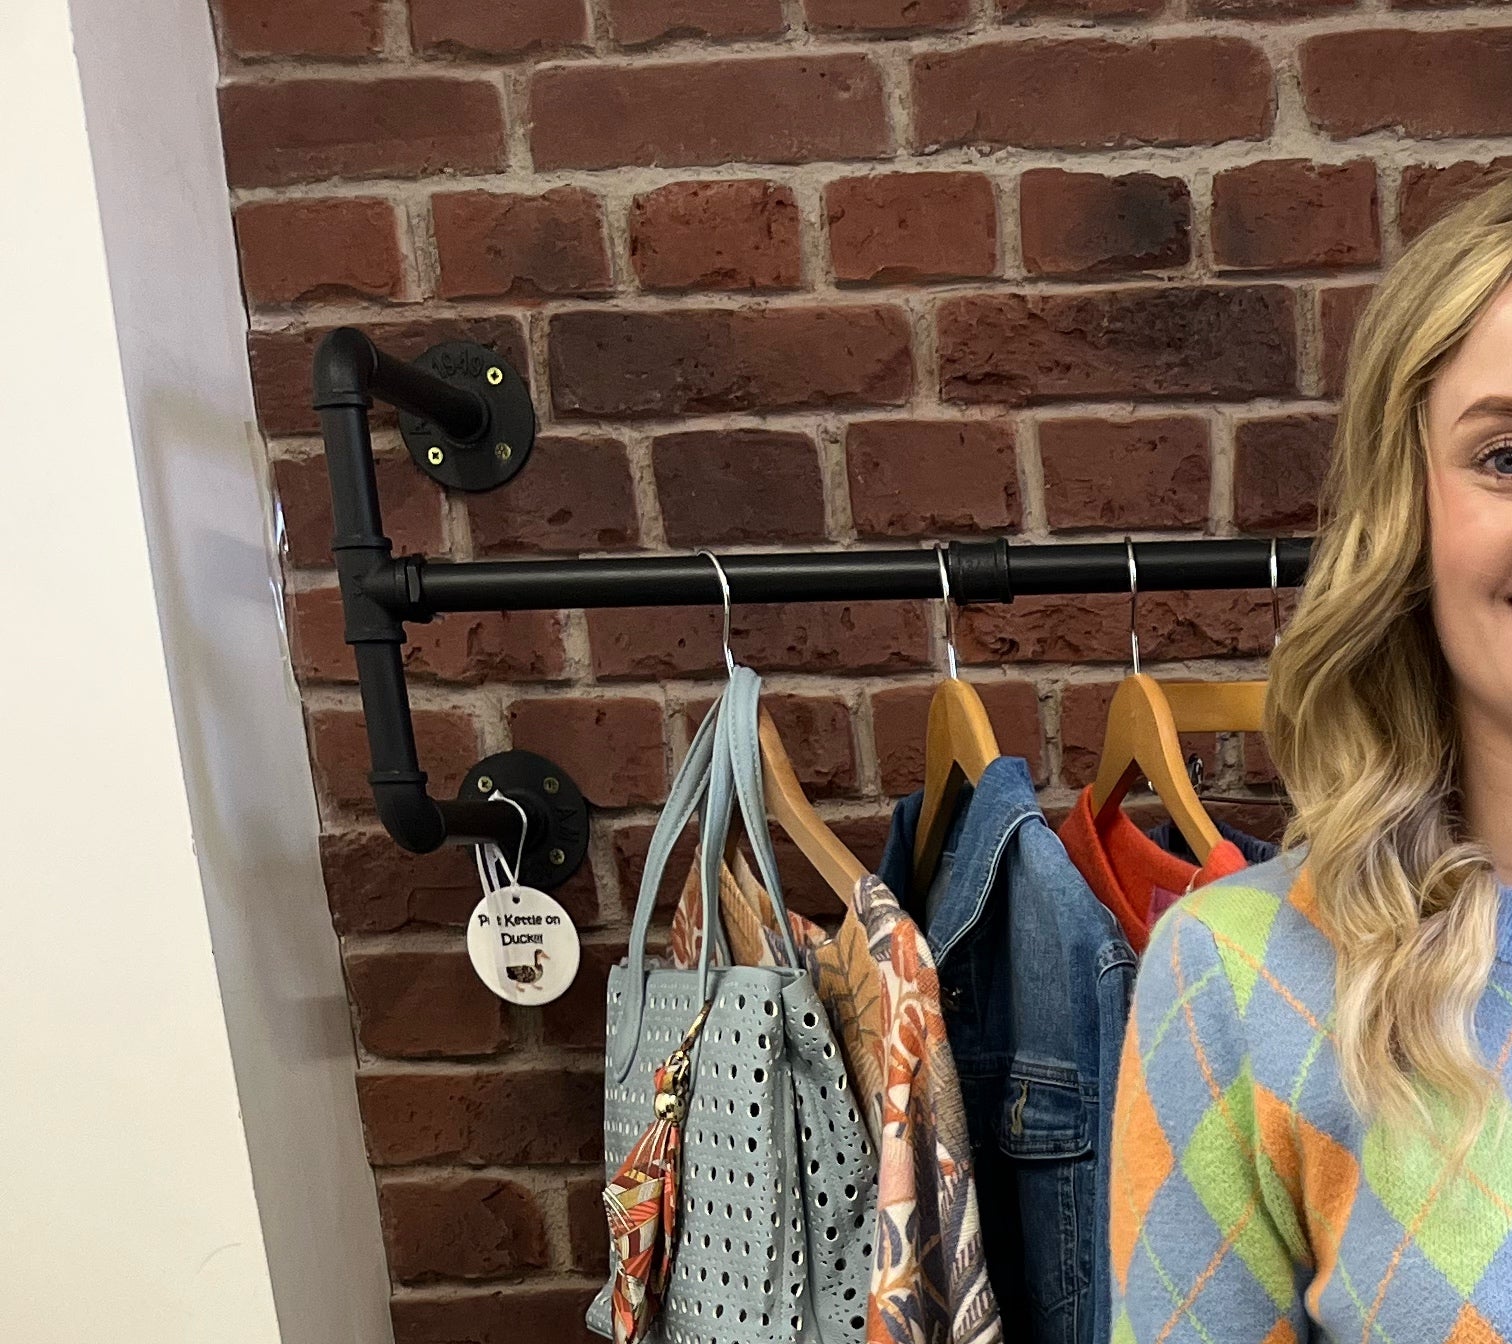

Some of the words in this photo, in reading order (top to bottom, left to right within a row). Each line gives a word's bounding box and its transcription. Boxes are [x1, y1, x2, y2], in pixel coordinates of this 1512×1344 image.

[478, 914, 502, 927] Pt
[504, 914, 542, 927] Kettle
[545, 915, 561, 926] on
